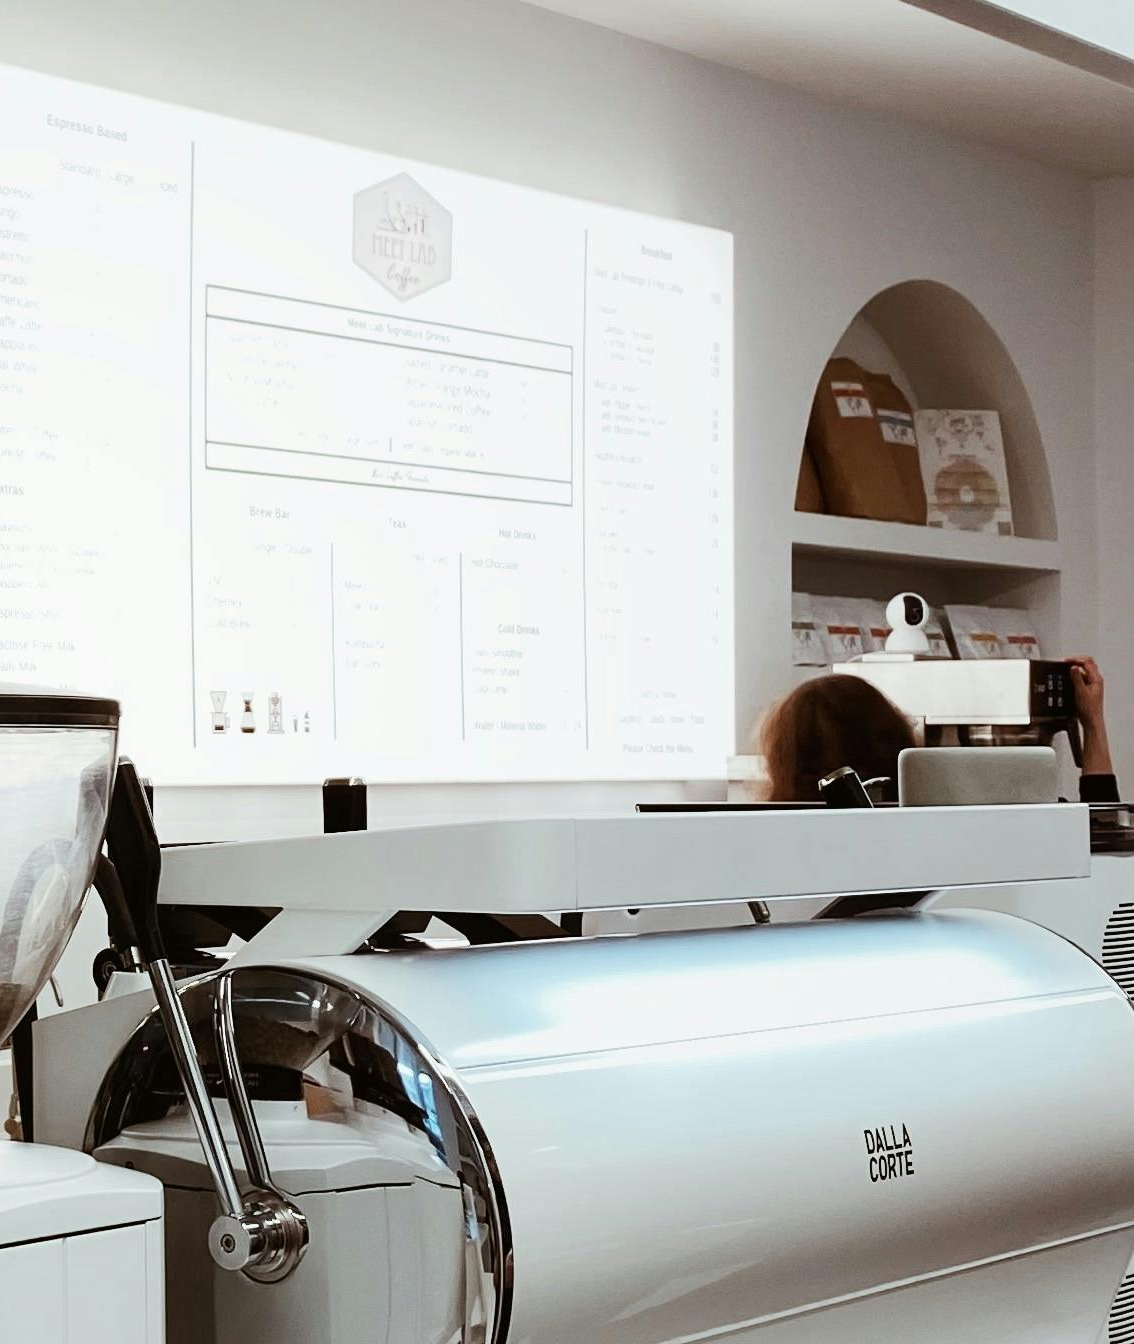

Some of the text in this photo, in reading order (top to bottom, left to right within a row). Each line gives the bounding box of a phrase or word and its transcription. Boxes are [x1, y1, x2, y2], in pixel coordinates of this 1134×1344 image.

[46, 113, 128, 143] Espresso Based
[371, 233, 437, 265] MEET LAB
[863, 1122, 912, 1155] DALLA
[869, 1150, 915, 1183] CORTE
